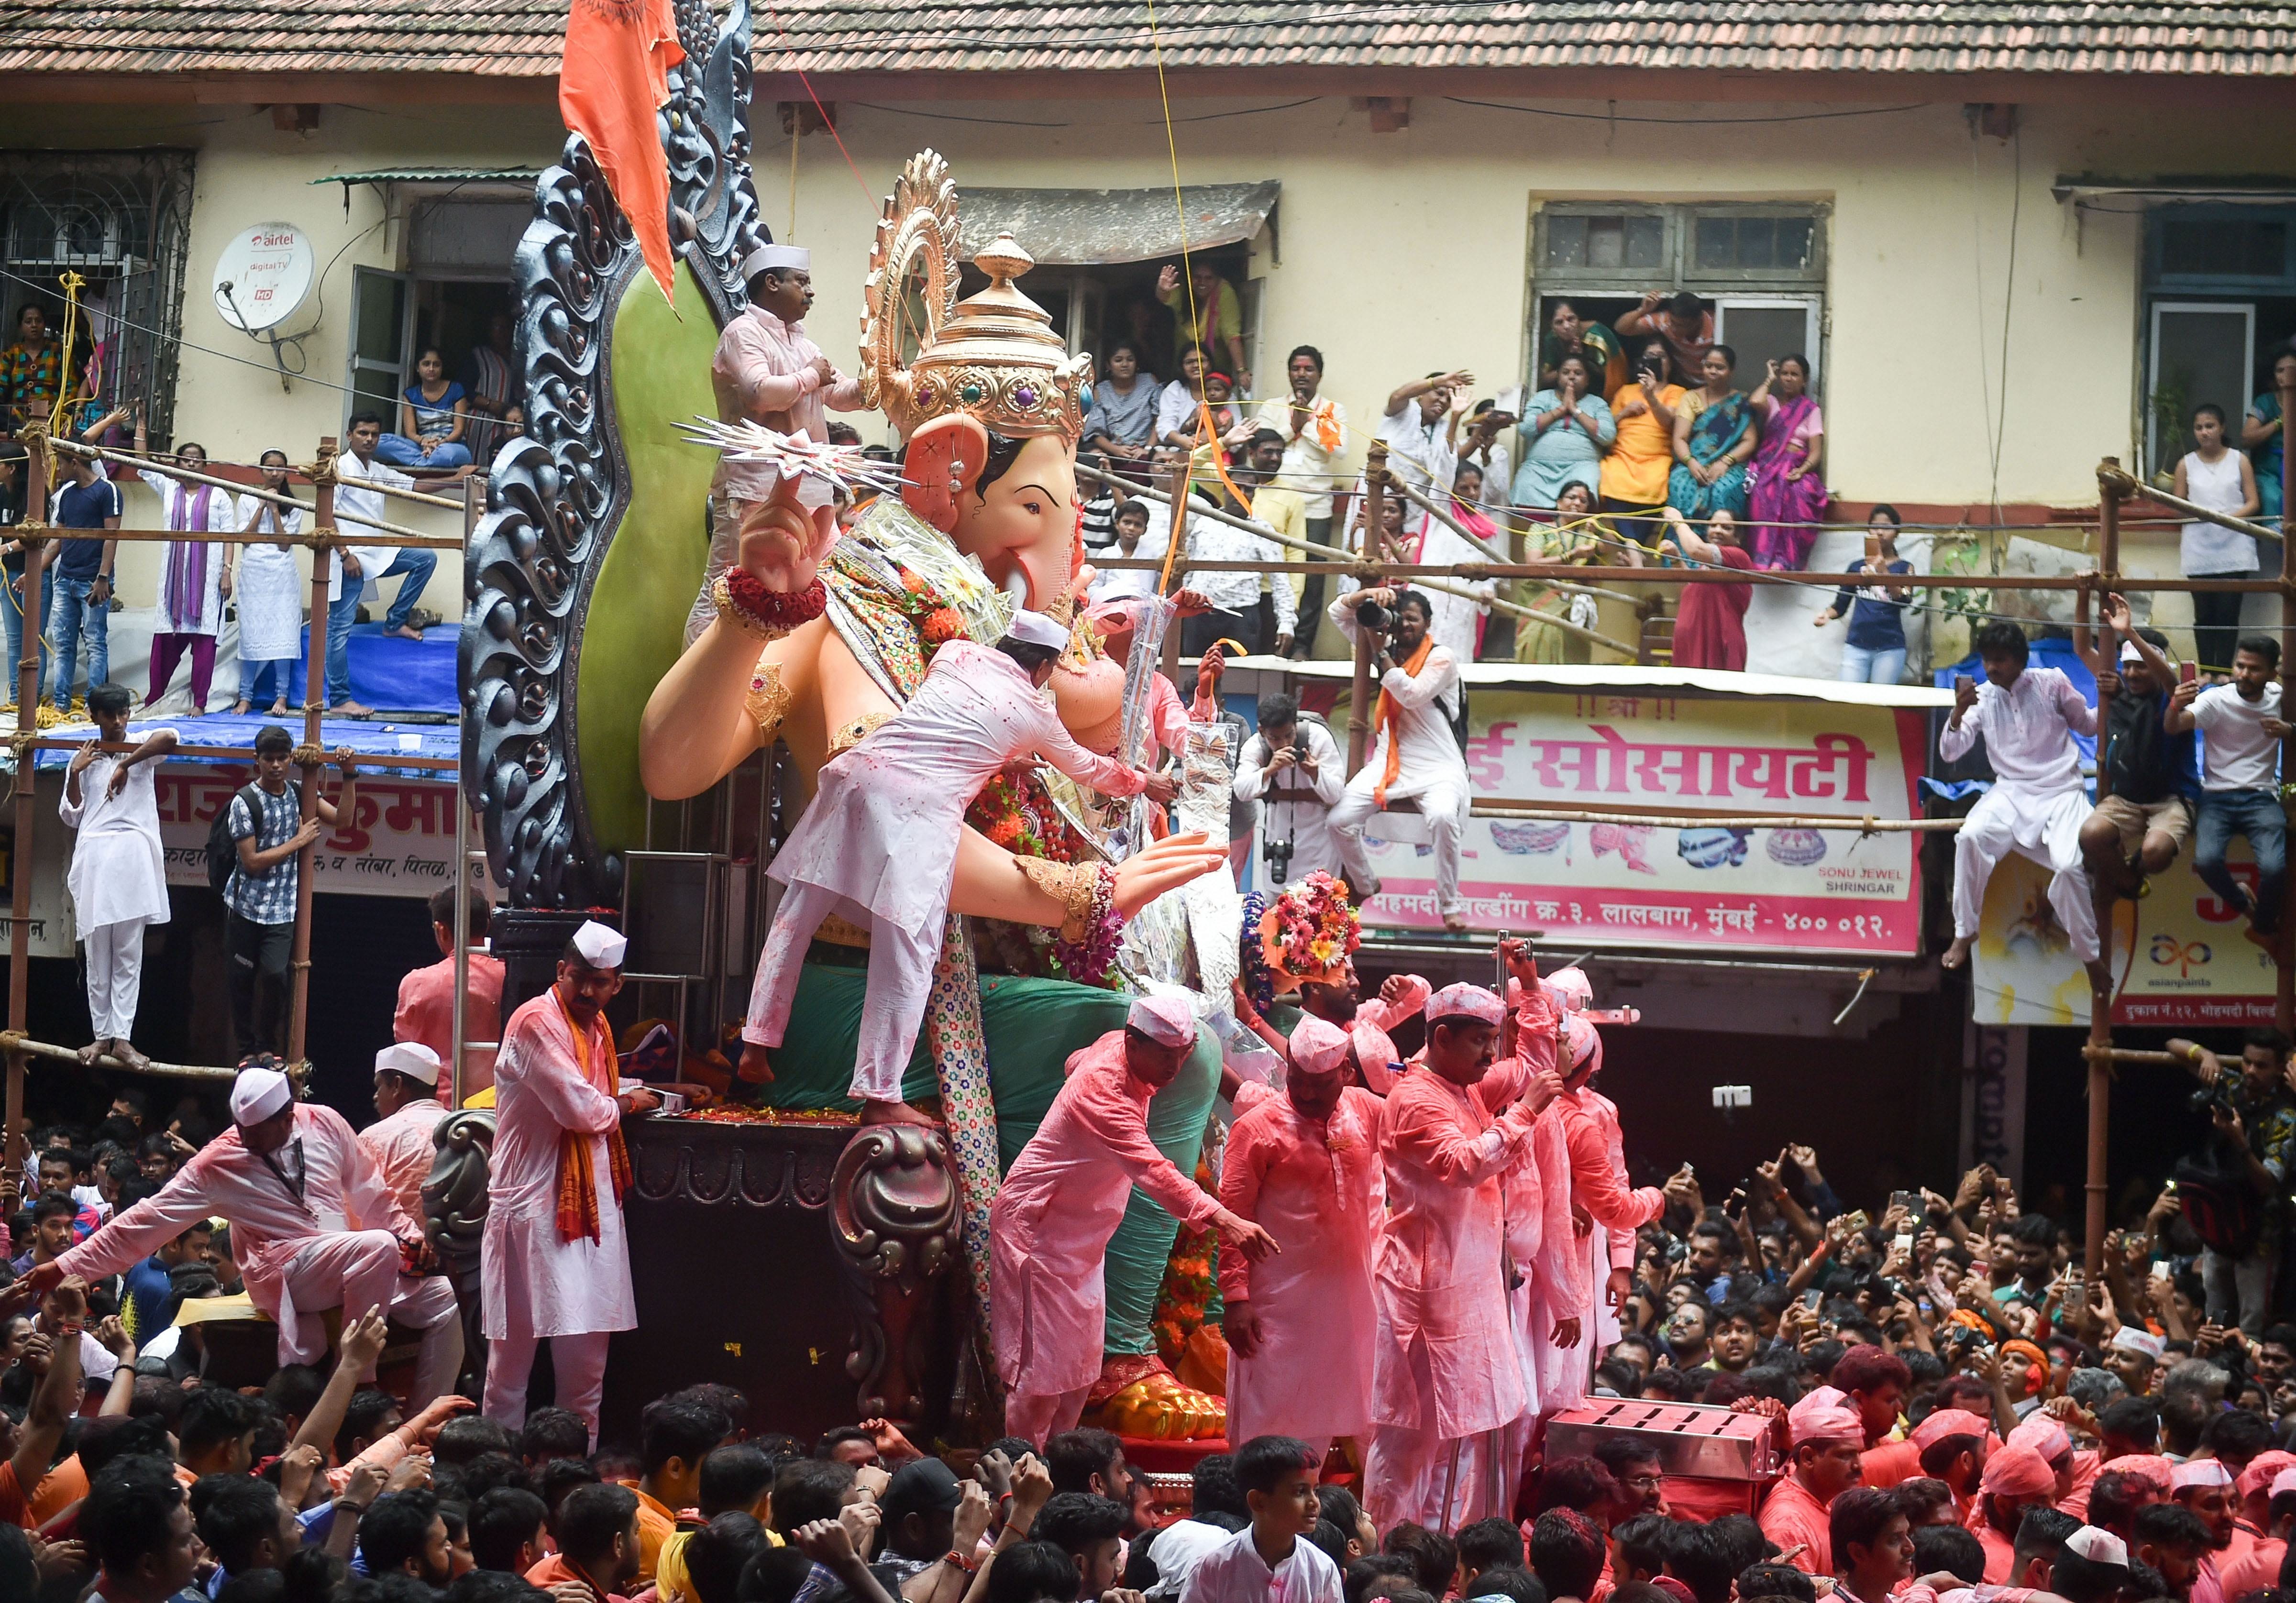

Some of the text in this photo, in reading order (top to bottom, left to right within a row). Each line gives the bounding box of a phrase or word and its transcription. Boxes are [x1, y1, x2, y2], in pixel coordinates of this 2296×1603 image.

[264, 233, 294, 246] airtel
[250, 262, 276, 272] digital
[255, 290, 272, 300] HD
[1530, 724, 1876, 802] सोसायटी
[1819, 867, 1903, 880] SONU JEWEL
[1826, 880, 1895, 894] SHRINGAR
[1599, 903, 1698, 931] लालबाग,
[1705, 902, 1758, 935] मुंबई
[1783, 912, 1827, 931] ४००
